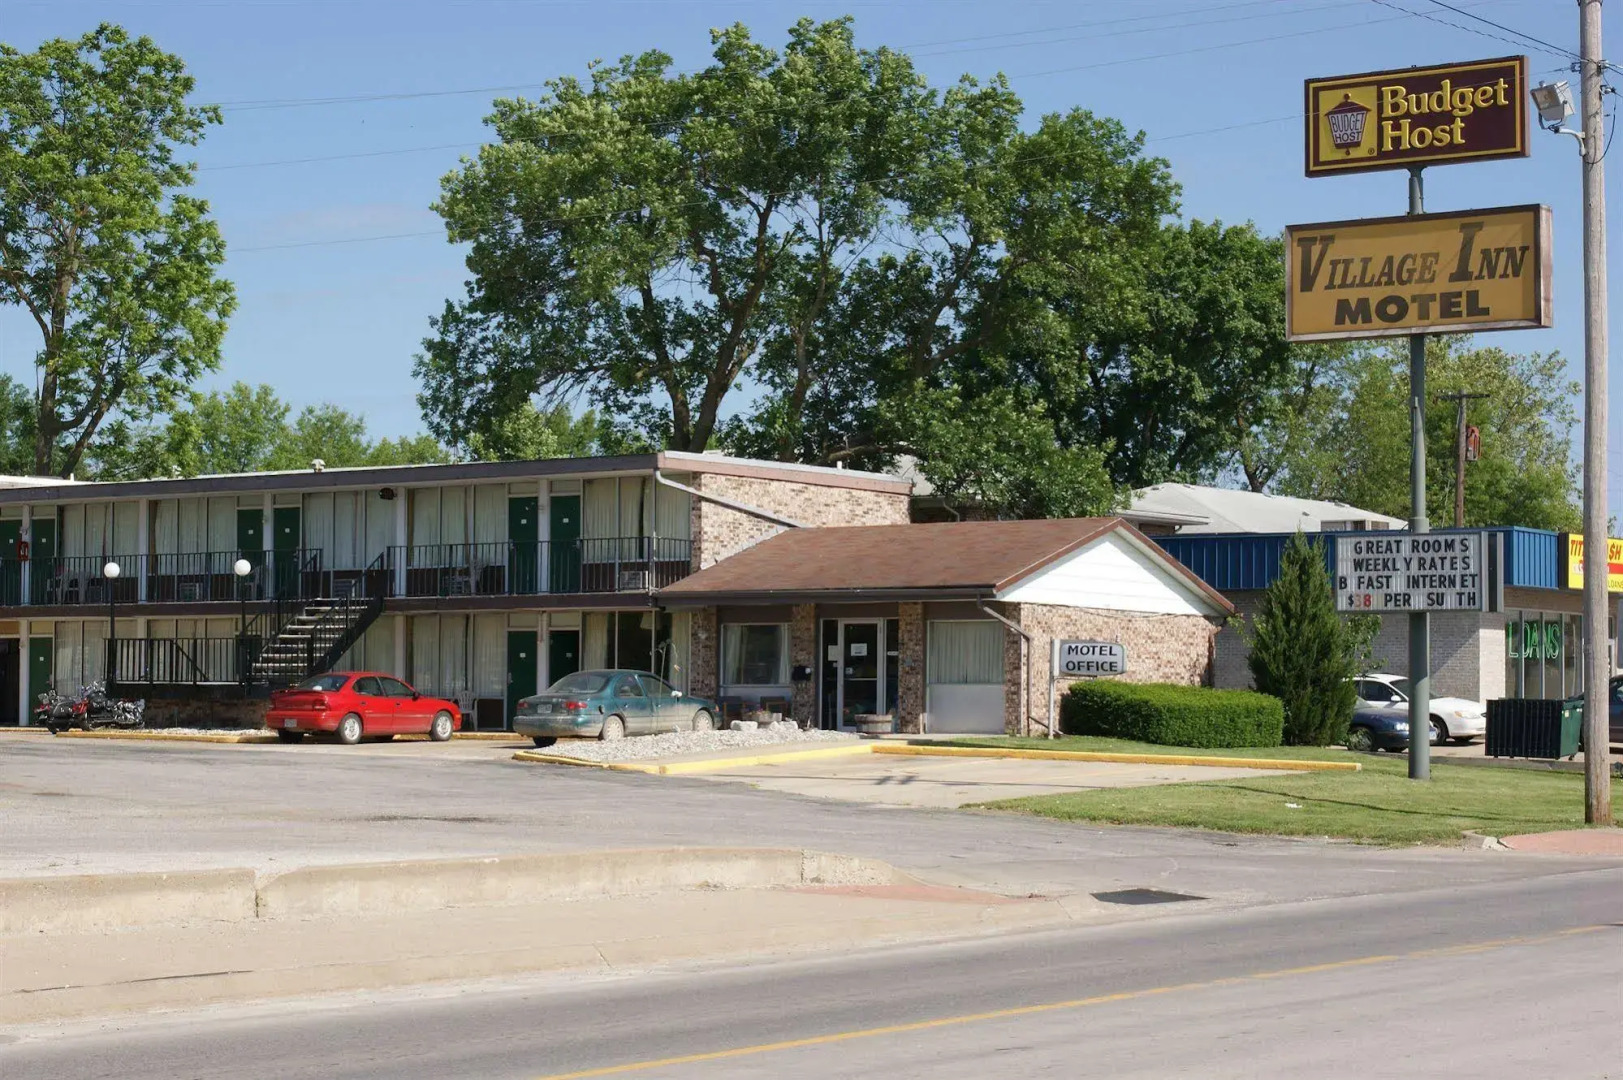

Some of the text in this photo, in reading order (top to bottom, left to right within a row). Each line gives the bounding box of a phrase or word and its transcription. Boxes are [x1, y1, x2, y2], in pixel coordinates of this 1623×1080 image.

[1382, 78, 1508, 118] Budget
[1331, 112, 1365, 132] BUDGET
[1334, 131, 1362, 142] HOST
[1382, 118, 1466, 152] Host
[1296, 221, 1530, 293] VILLAGE INN
[1334, 290, 1490, 326] MOTEL
[1354, 538, 1468, 555] GREAT ROOMS
[1353, 556, 1470, 572] WEEKLY RATES
[1406, 574, 1478, 589] INTERNET
[1384, 593, 1412, 608] PER
[1427, 592, 1444, 607] SU
[1456, 592, 1476, 606] TH
[1508, 621, 1560, 659] LOANS
[1068, 645, 1117, 656] MOTEL
[1066, 660, 1118, 672] OFFICE
